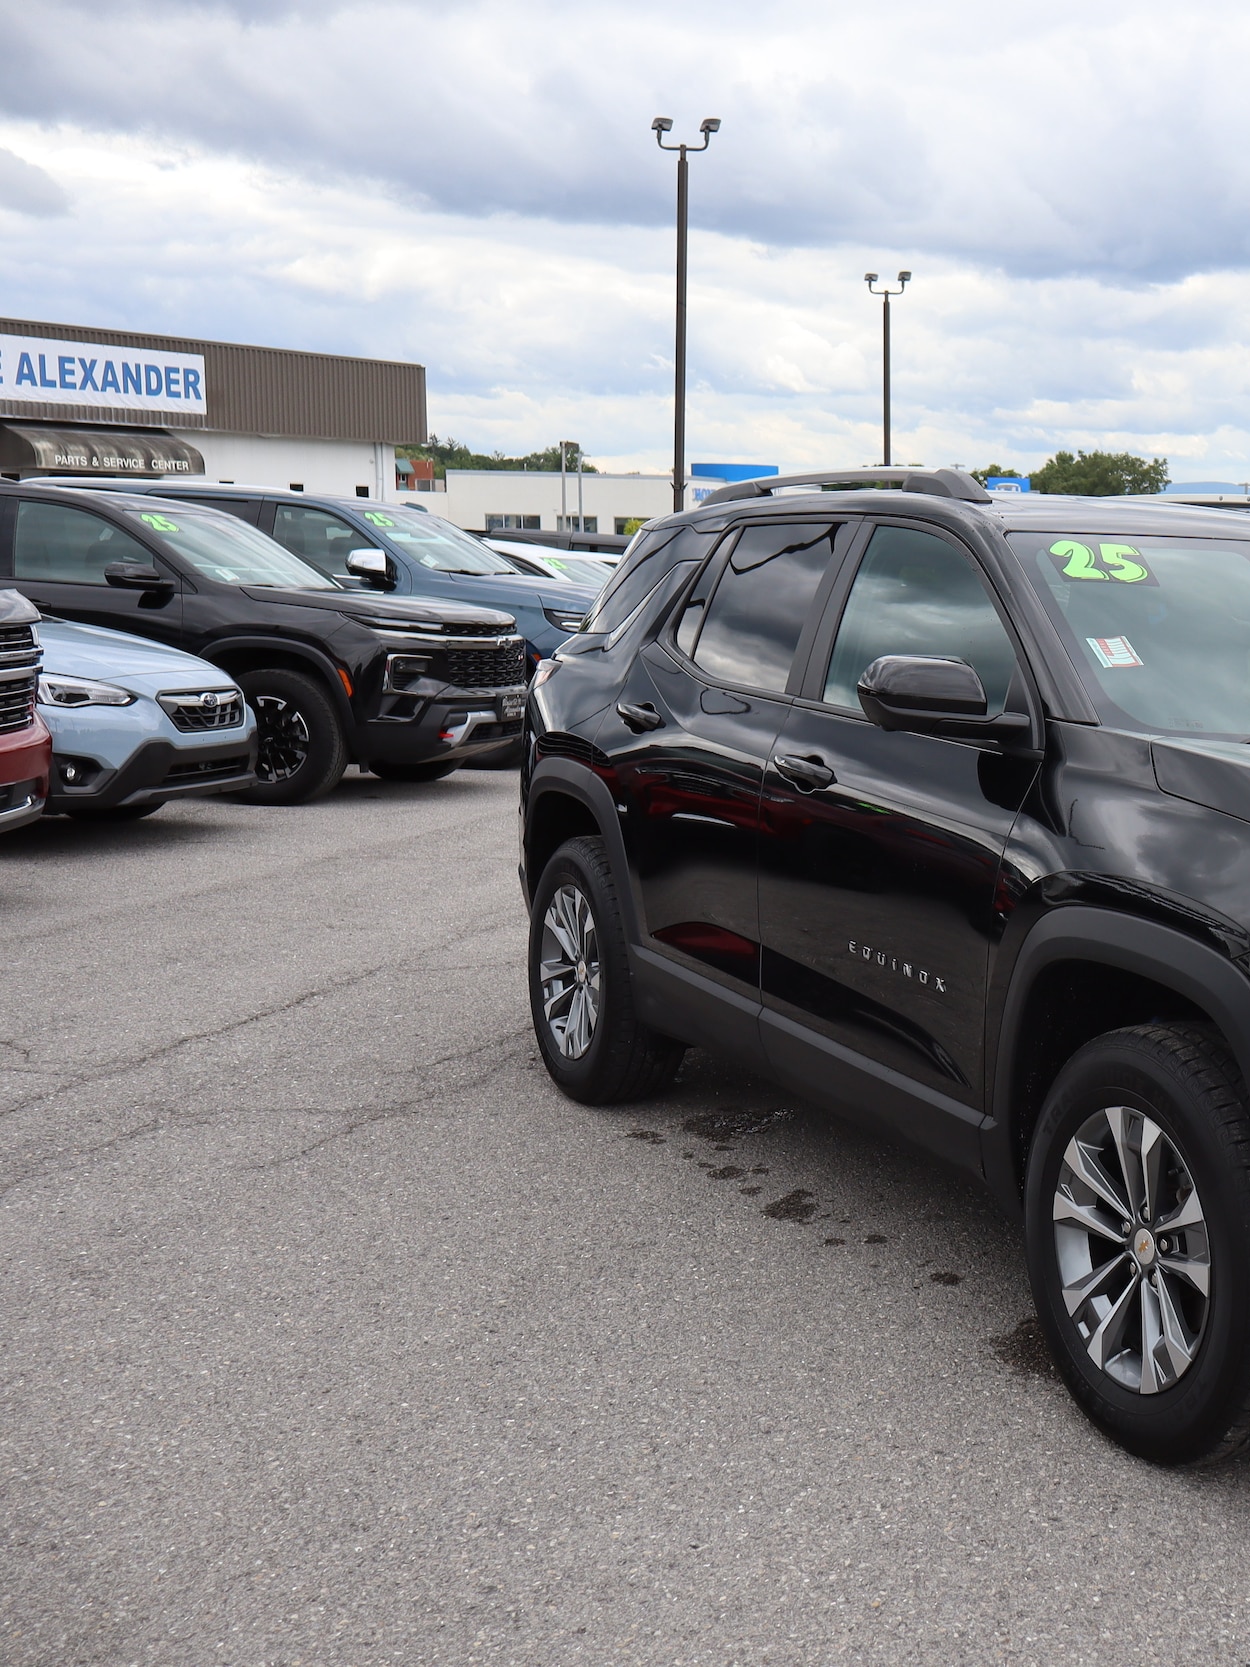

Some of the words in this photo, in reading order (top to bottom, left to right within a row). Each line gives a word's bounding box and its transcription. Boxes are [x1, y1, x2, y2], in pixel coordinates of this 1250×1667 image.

[15, 352, 202, 400] ALEXANDER
[55, 454, 88, 466] PARTS
[92, 456, 99, 467] &
[104, 457, 145, 469] SERVICE
[151, 459, 190, 471] CENTER
[141, 513, 180, 533] 25
[364, 511, 396, 528] 25
[1049, 540, 1148, 583] 25
[848, 940, 948, 994] EQUINOX
